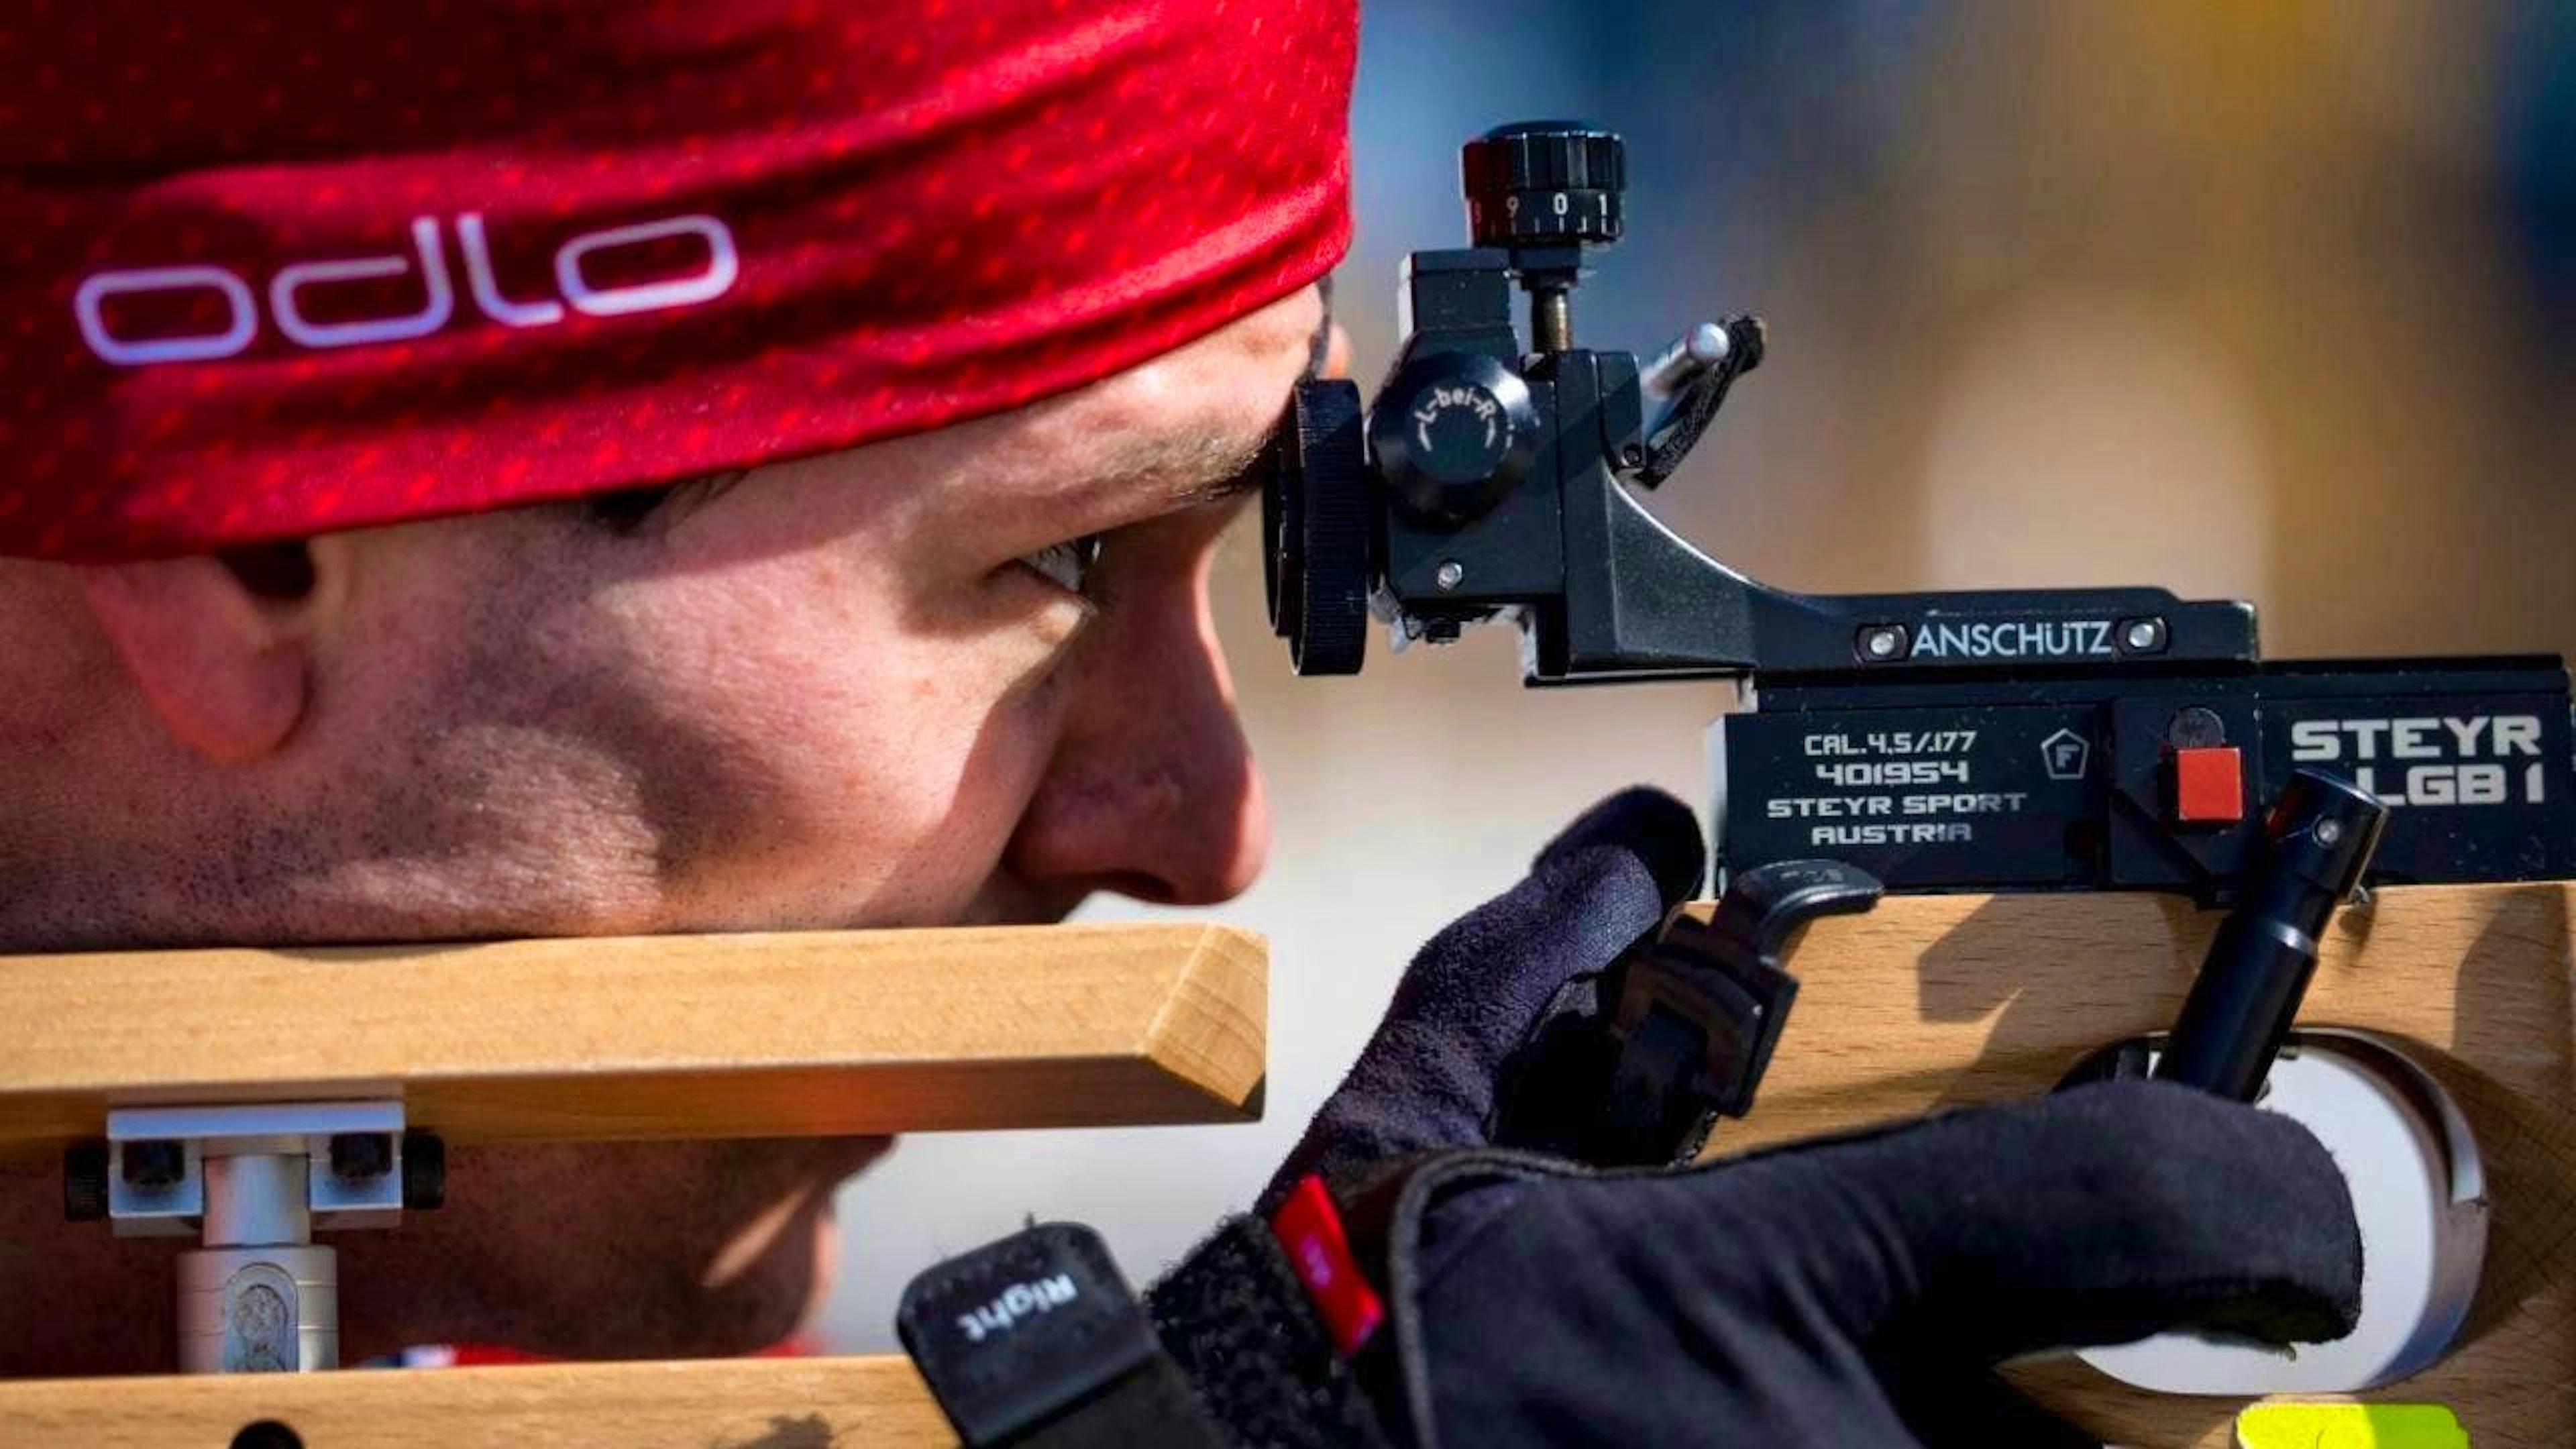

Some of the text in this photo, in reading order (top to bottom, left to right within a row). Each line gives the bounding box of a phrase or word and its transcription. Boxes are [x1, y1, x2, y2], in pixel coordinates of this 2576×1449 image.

[1507, 195, 1520, 219] 9
[1552, 191, 1569, 215] 0
[1598, 193, 1608, 216] 1
[74, 213, 739, 366] odlo
[1911, 621, 2112, 657] ANSCHÜTZ
[2291, 715, 2541, 761] STEYR
[1815, 760, 1970, 787] 401954
[1767, 792, 2027, 818] STEYR SPORT
[1811, 822, 1973, 846] AUSTRIA
[957, 1273, 1079, 1341] Right
